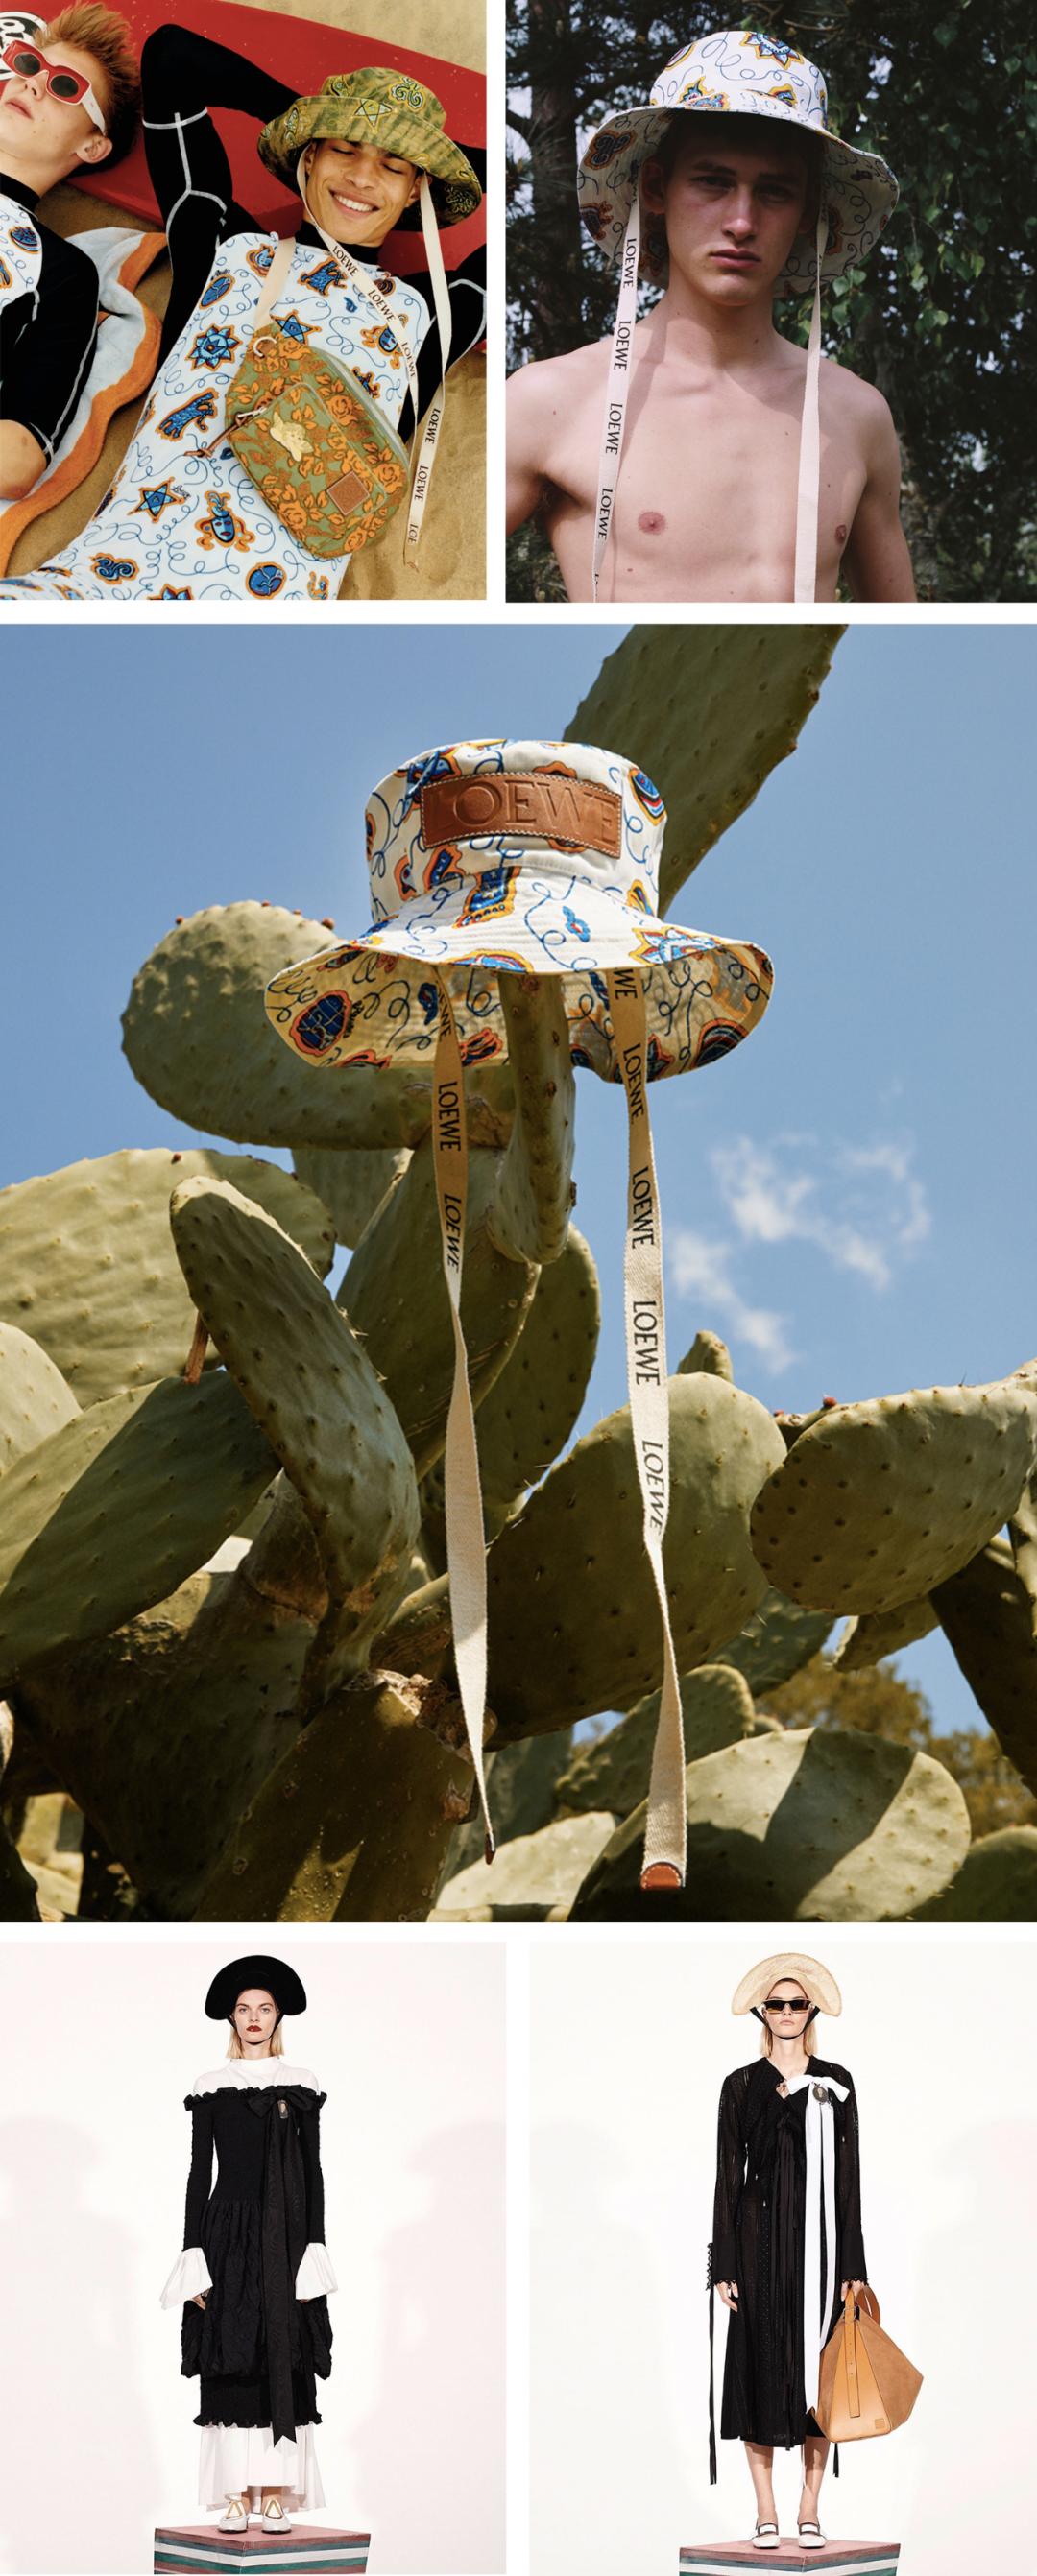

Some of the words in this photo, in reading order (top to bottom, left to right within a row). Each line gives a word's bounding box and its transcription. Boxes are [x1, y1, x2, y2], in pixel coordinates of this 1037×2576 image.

[332, 245, 359, 277] LOEWE
[368, 289, 396, 322] LOEWE
[622, 238, 637, 289] LOEWE
[614, 321, 631, 370] LOEWE
[424, 409, 441, 443] LOEWE
[605, 403, 623, 455] LOEWE
[414, 465, 429, 502] LOEWE
[598, 488, 613, 540] LOEWE
[438, 1081, 461, 1151] LOEWE
[623, 1043, 644, 1125] LOEWE
[444, 1194, 461, 1273] LOEWE
[632, 1166, 654, 1249] LOEWE
[633, 1300, 660, 1386] LOEWE
[641, 1440, 664, 1536] LOEWE
